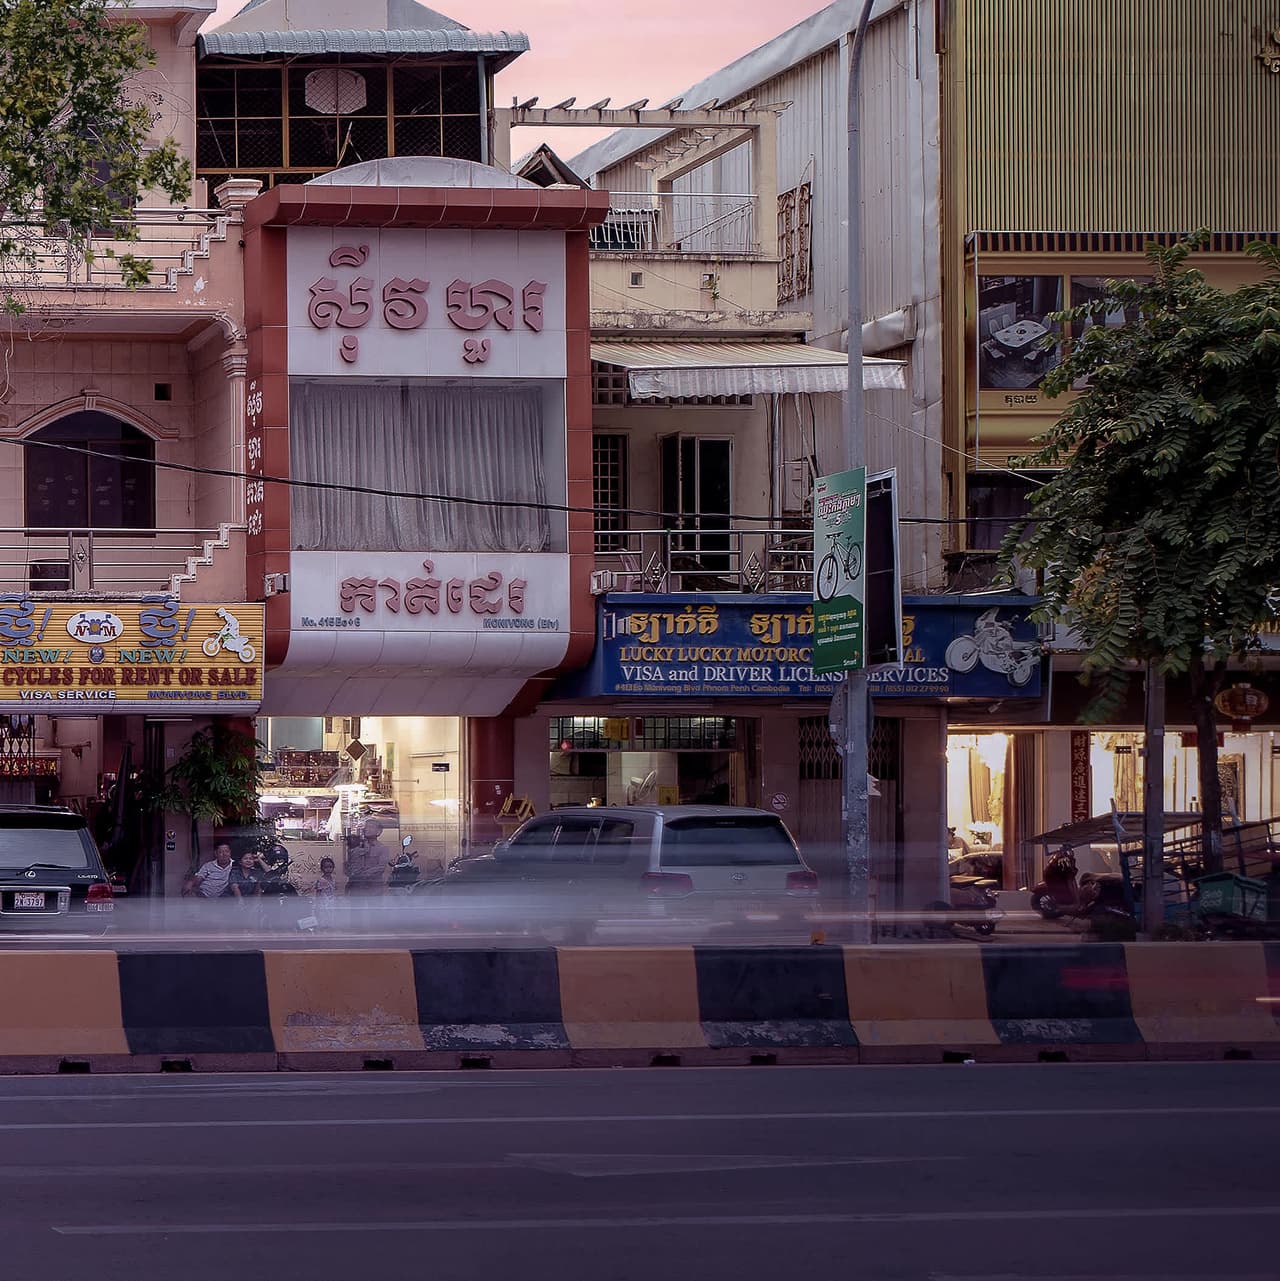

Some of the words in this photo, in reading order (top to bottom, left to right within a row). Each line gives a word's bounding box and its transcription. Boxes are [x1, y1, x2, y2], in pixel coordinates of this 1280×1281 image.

[2, 649, 73, 663] NEW!
[118, 649, 188, 663] NEW!
[620, 647, 674, 662] LUCKY
[678, 647, 734, 662] LUCKY
[738, 647, 814, 662] MOTORC
[3, 667, 74, 685] CYCLES
[79, 667, 116, 685] FOR
[121, 667, 174, 685] RENT
[178, 667, 204, 685] OR
[208, 667, 257, 685] SALE
[621, 666, 663, 681] VISA
[669, 666, 698, 681] and
[704, 666, 773, 681] DRIVER
[778, 666, 848, 682] LICENS
[20, 690, 52, 699] VISA
[58, 690, 116, 699] SERVICE
